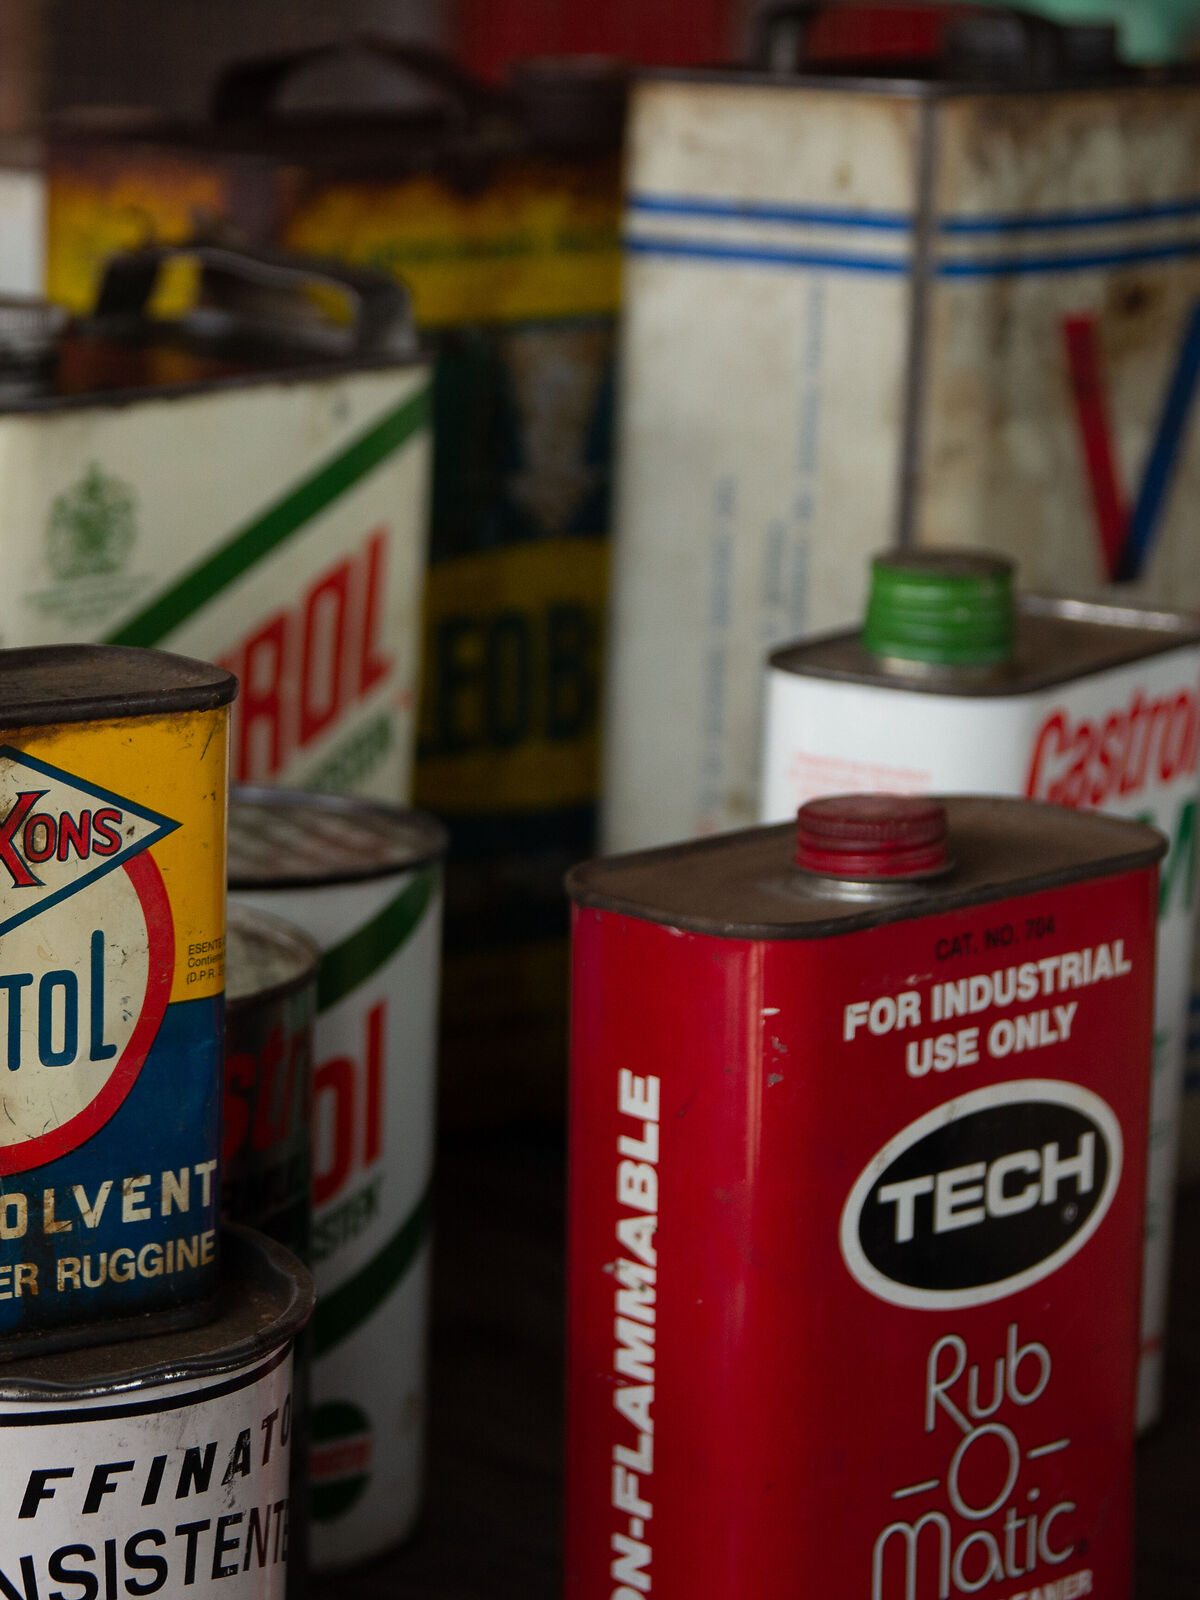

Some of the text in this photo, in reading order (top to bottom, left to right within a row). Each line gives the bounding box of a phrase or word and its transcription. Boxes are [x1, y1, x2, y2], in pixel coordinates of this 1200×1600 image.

[1025, 685, 1200, 812] Castro
[842, 938, 1133, 1043] FOR INDUSTRIAL
[905, 1001, 1079, 1079] USE ONLY
[877, 1131, 1096, 1245] TECH
[56, 1230, 216, 1293] RUGGINE
[924, 1322, 1052, 1434] Rub
